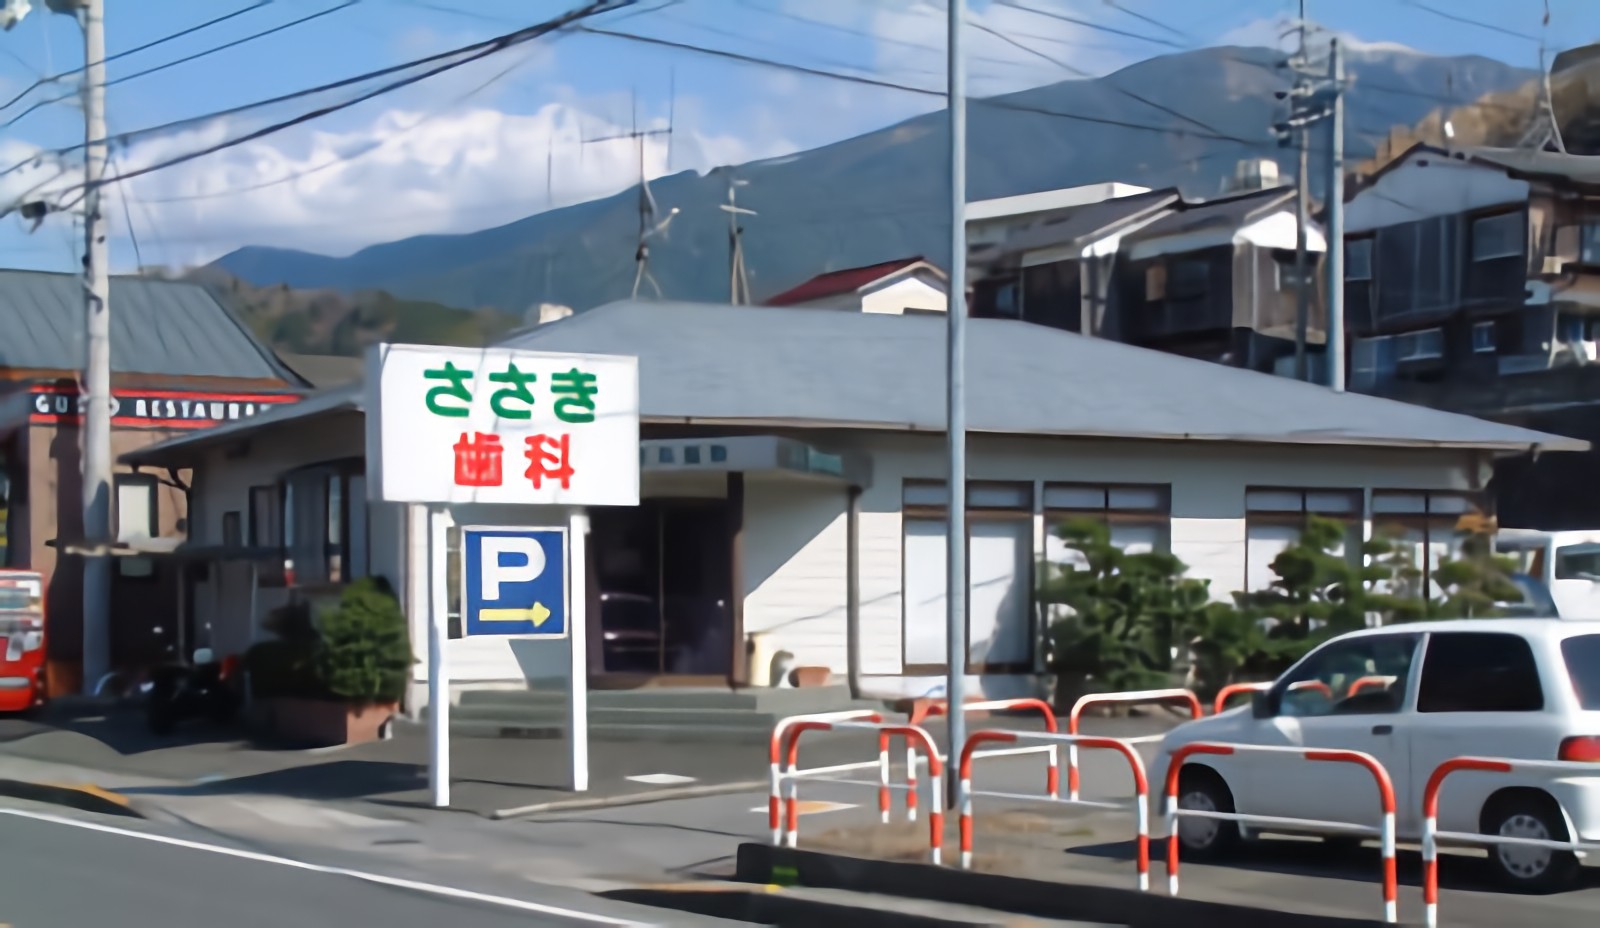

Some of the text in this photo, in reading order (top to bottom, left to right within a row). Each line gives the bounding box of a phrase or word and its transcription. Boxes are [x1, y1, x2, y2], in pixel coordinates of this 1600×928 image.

[423, 361, 599, 423] ささき
[453, 431, 576, 490] 歯科
[480, 535, 547, 601] P
